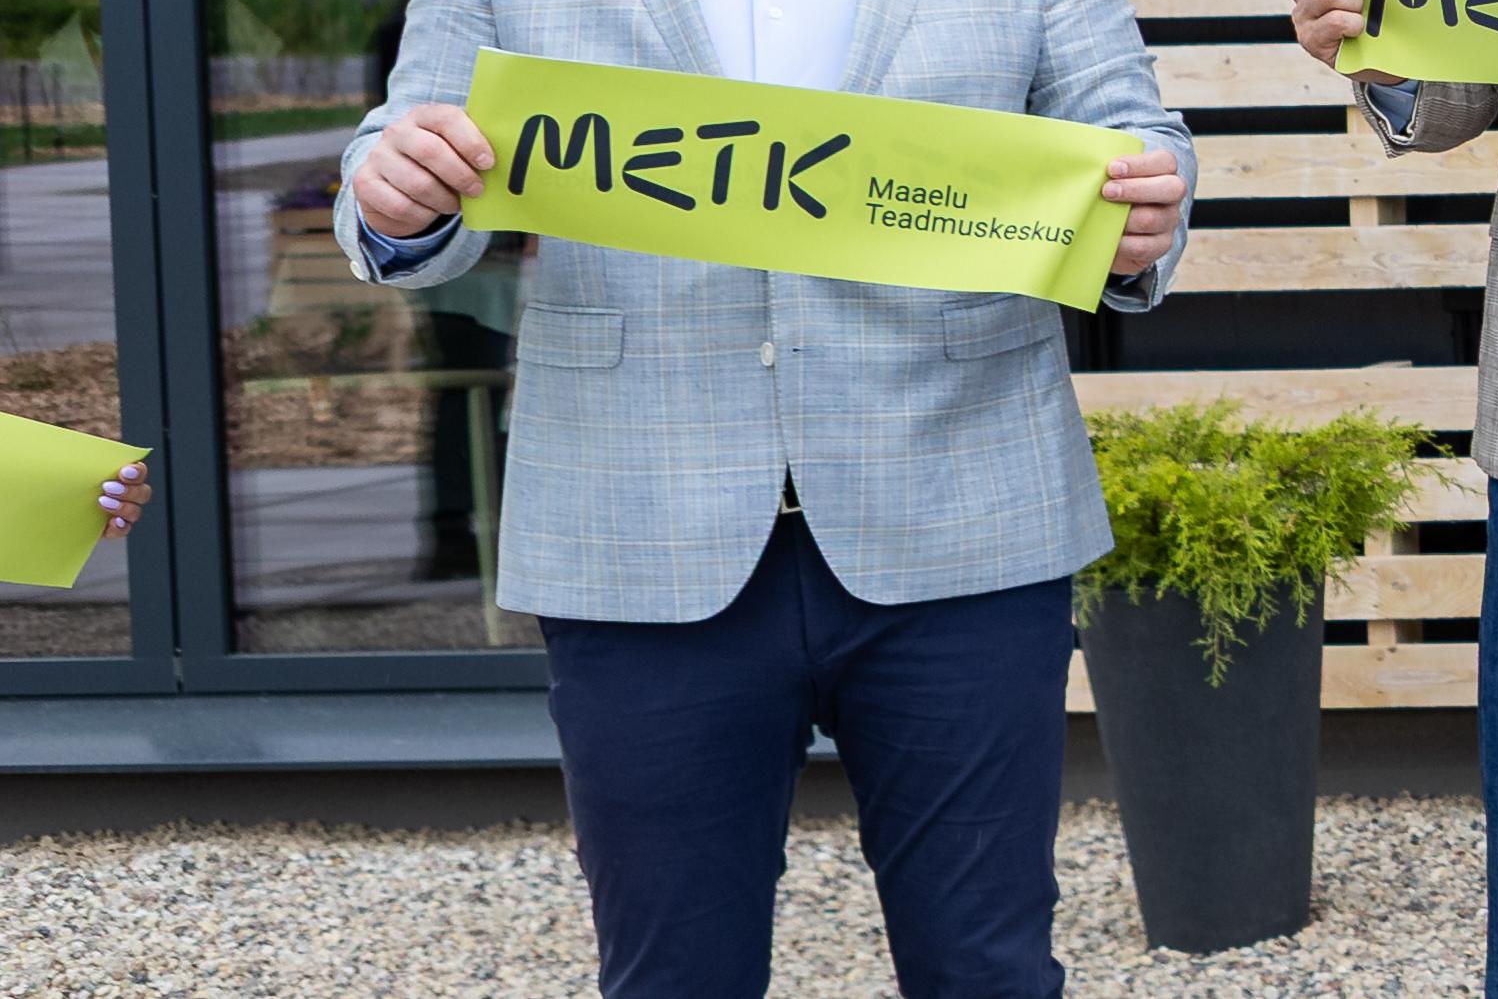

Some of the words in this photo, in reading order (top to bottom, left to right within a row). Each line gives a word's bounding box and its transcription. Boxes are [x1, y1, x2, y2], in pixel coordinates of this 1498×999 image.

[506, 112, 852, 220] METK
[868, 176, 968, 209] Maaelu
[865, 202, 1075, 246] Teadmuskeskus
